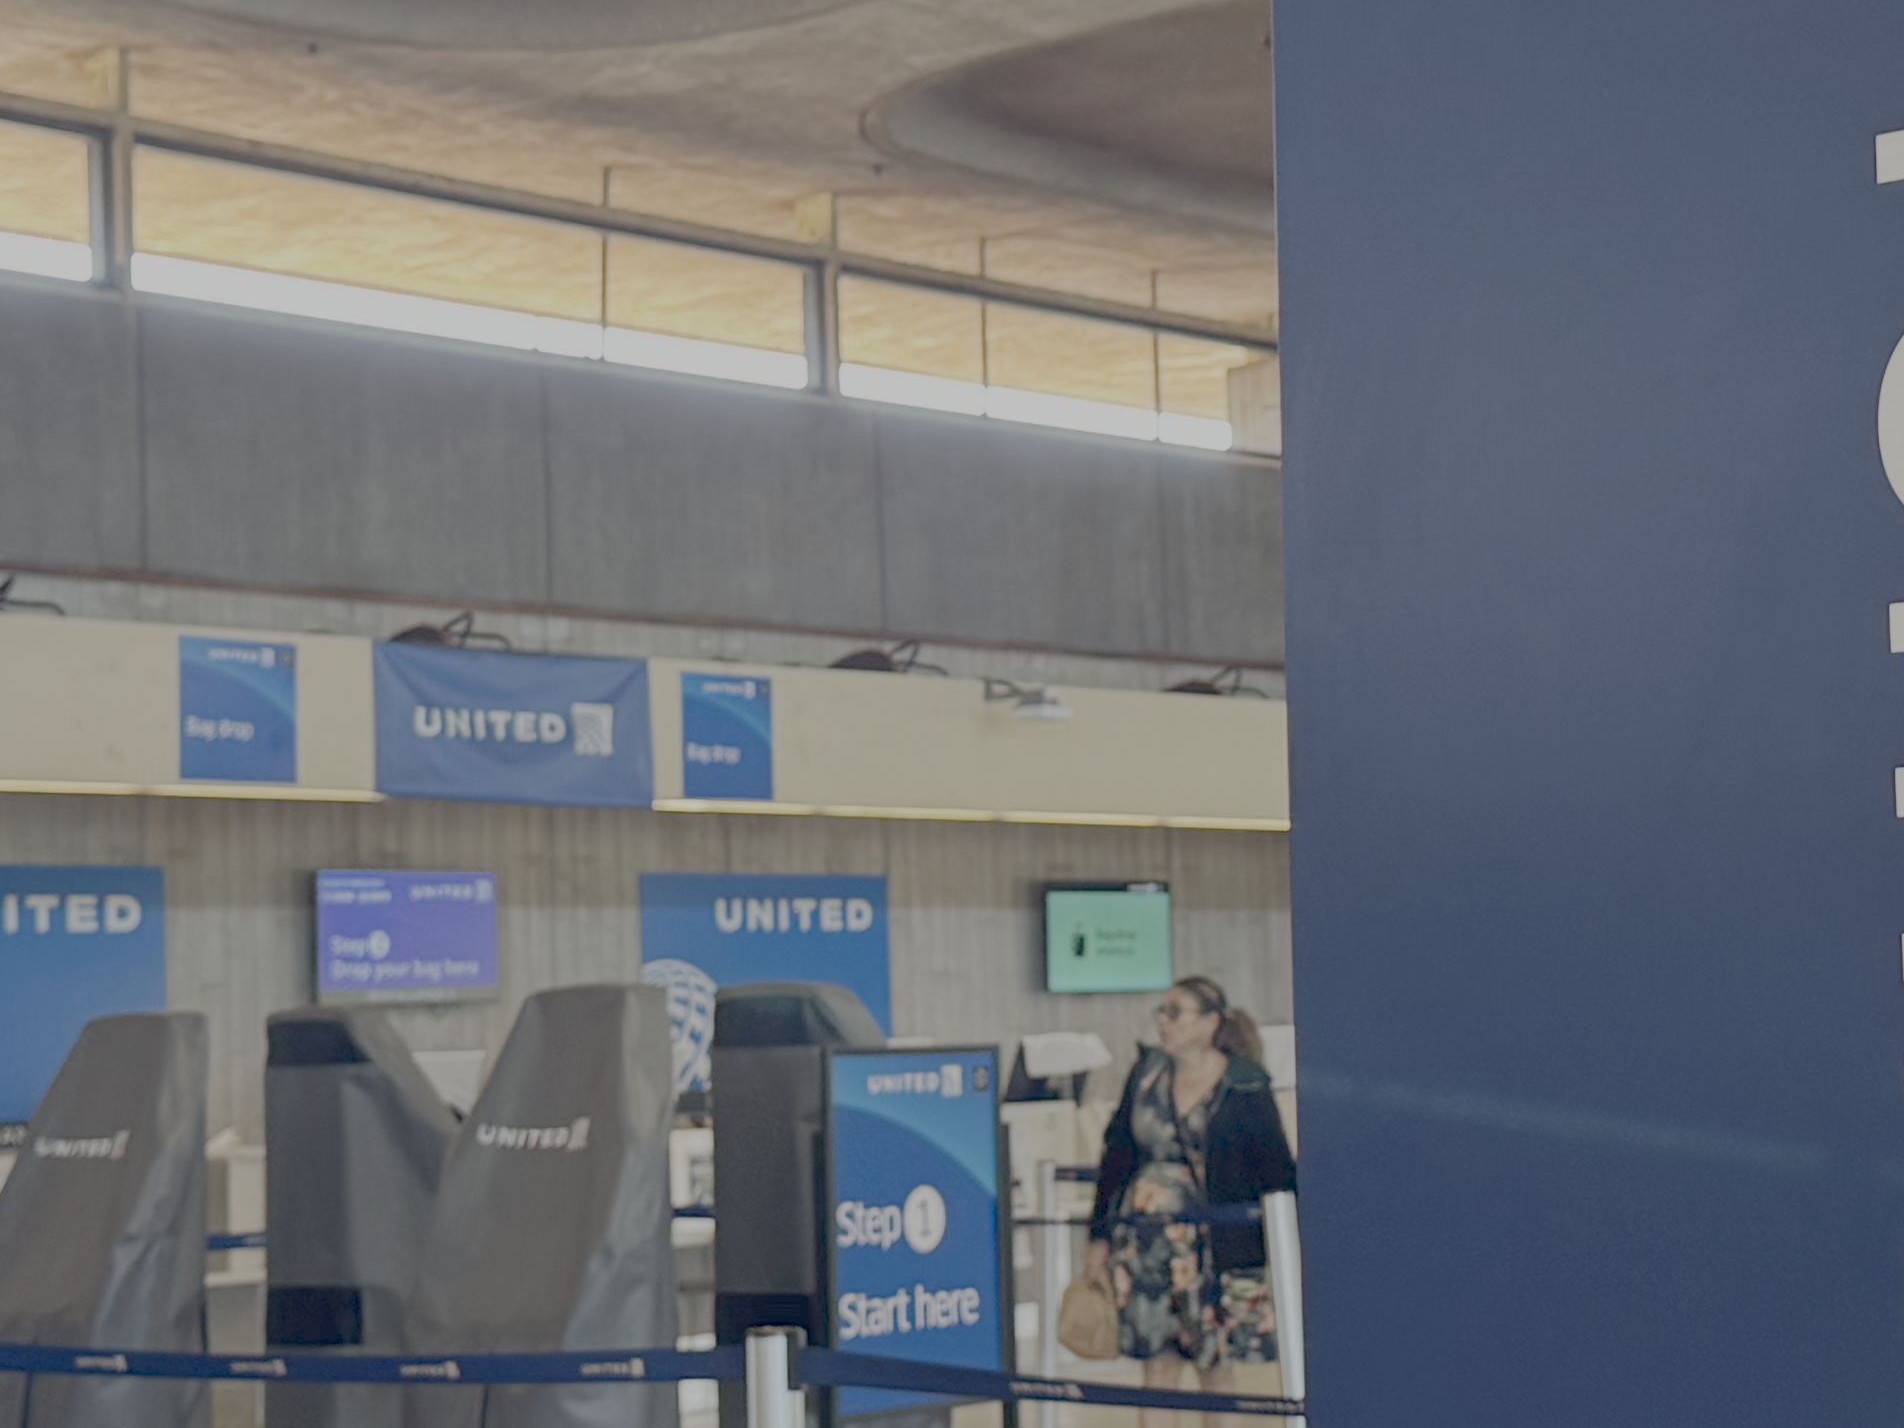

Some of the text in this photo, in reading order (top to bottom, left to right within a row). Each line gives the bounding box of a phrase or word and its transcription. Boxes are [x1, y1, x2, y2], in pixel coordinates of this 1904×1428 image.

[412, 704, 567, 744] UNITED
[714, 897, 874, 933] UNITED
[866, 1071, 941, 1096] UNITED
[475, 1123, 570, 1149] UNITED
[835, 1200, 902, 1252] Step
[837, 1283, 981, 1341] Start here
